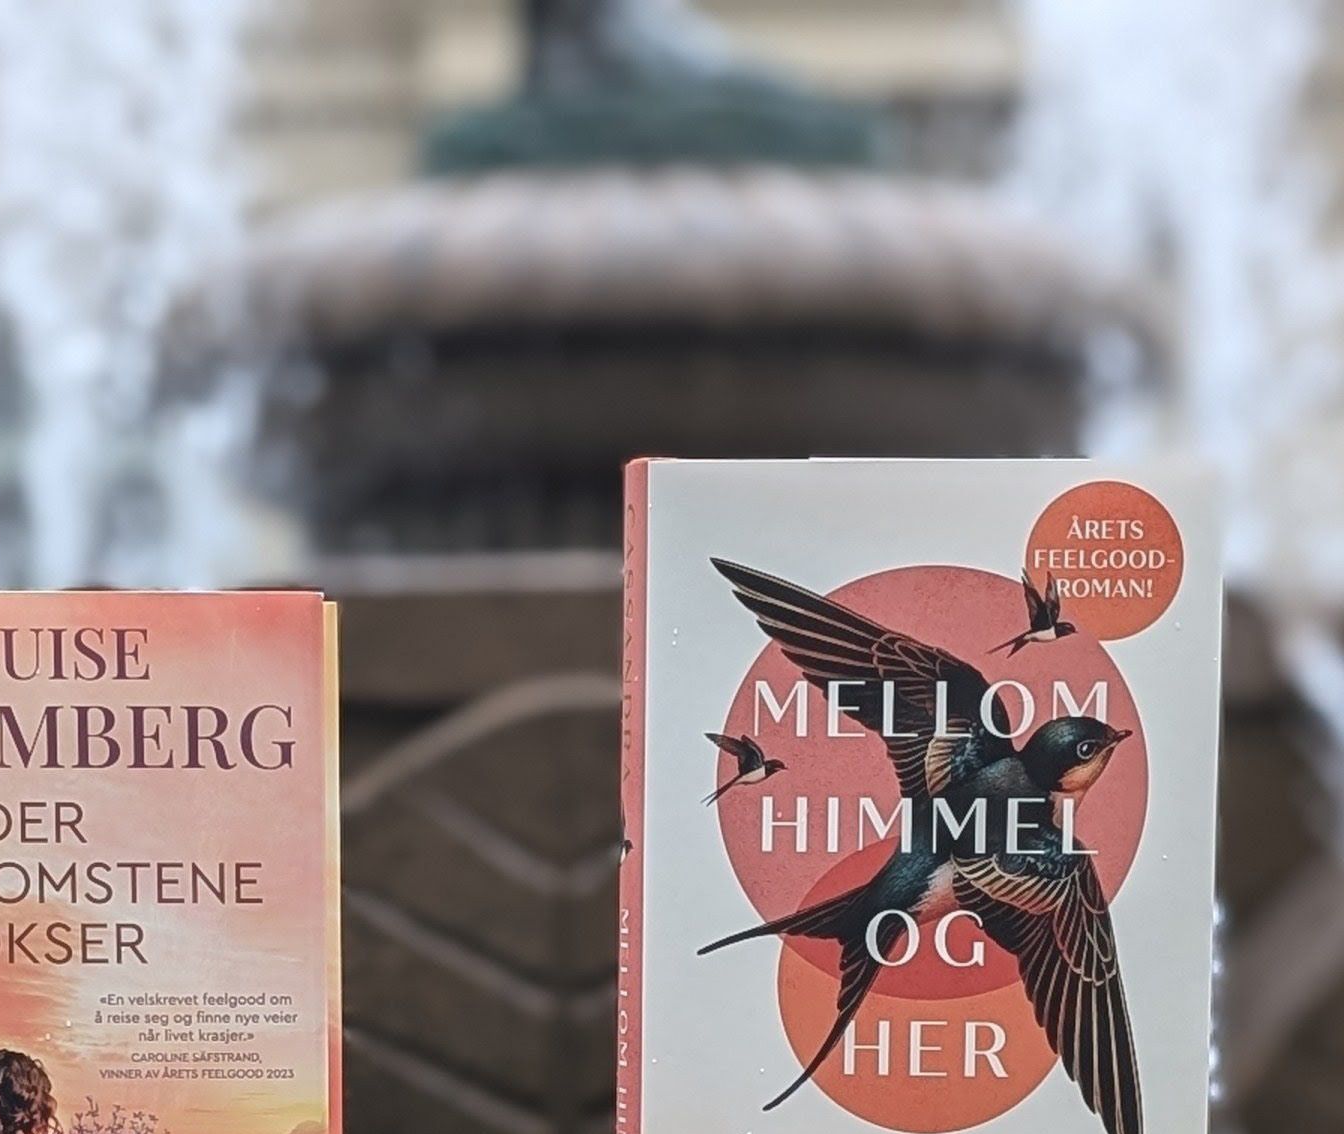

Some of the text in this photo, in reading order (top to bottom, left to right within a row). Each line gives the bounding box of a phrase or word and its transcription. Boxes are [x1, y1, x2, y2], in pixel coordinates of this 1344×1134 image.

[1066, 514, 1144, 541] ÅRETS
[1033, 549, 1176, 570] FEELGOOD-
[1056, 578, 1154, 600] ROMAN!
[753, 680, 1109, 738] MELLOM
[761, 796, 1099, 856] HIMMEL
[865, 909, 985, 967] OG
[128, 993, 198, 1006] velskrevet
[203, 993, 266, 1008] feelgood
[269, 996, 292, 1006] om
[94, 1011, 298, 1027] å reise seg og finne nye veier
[138, 1029, 255, 1045] når livet krasjer.»
[131, 1053, 190, 1063] CAROLINE
[842, 1020, 1009, 1080] HER
[99, 1067, 295, 1079] VINNER AV ÅRETS FEELGOOD 2023
